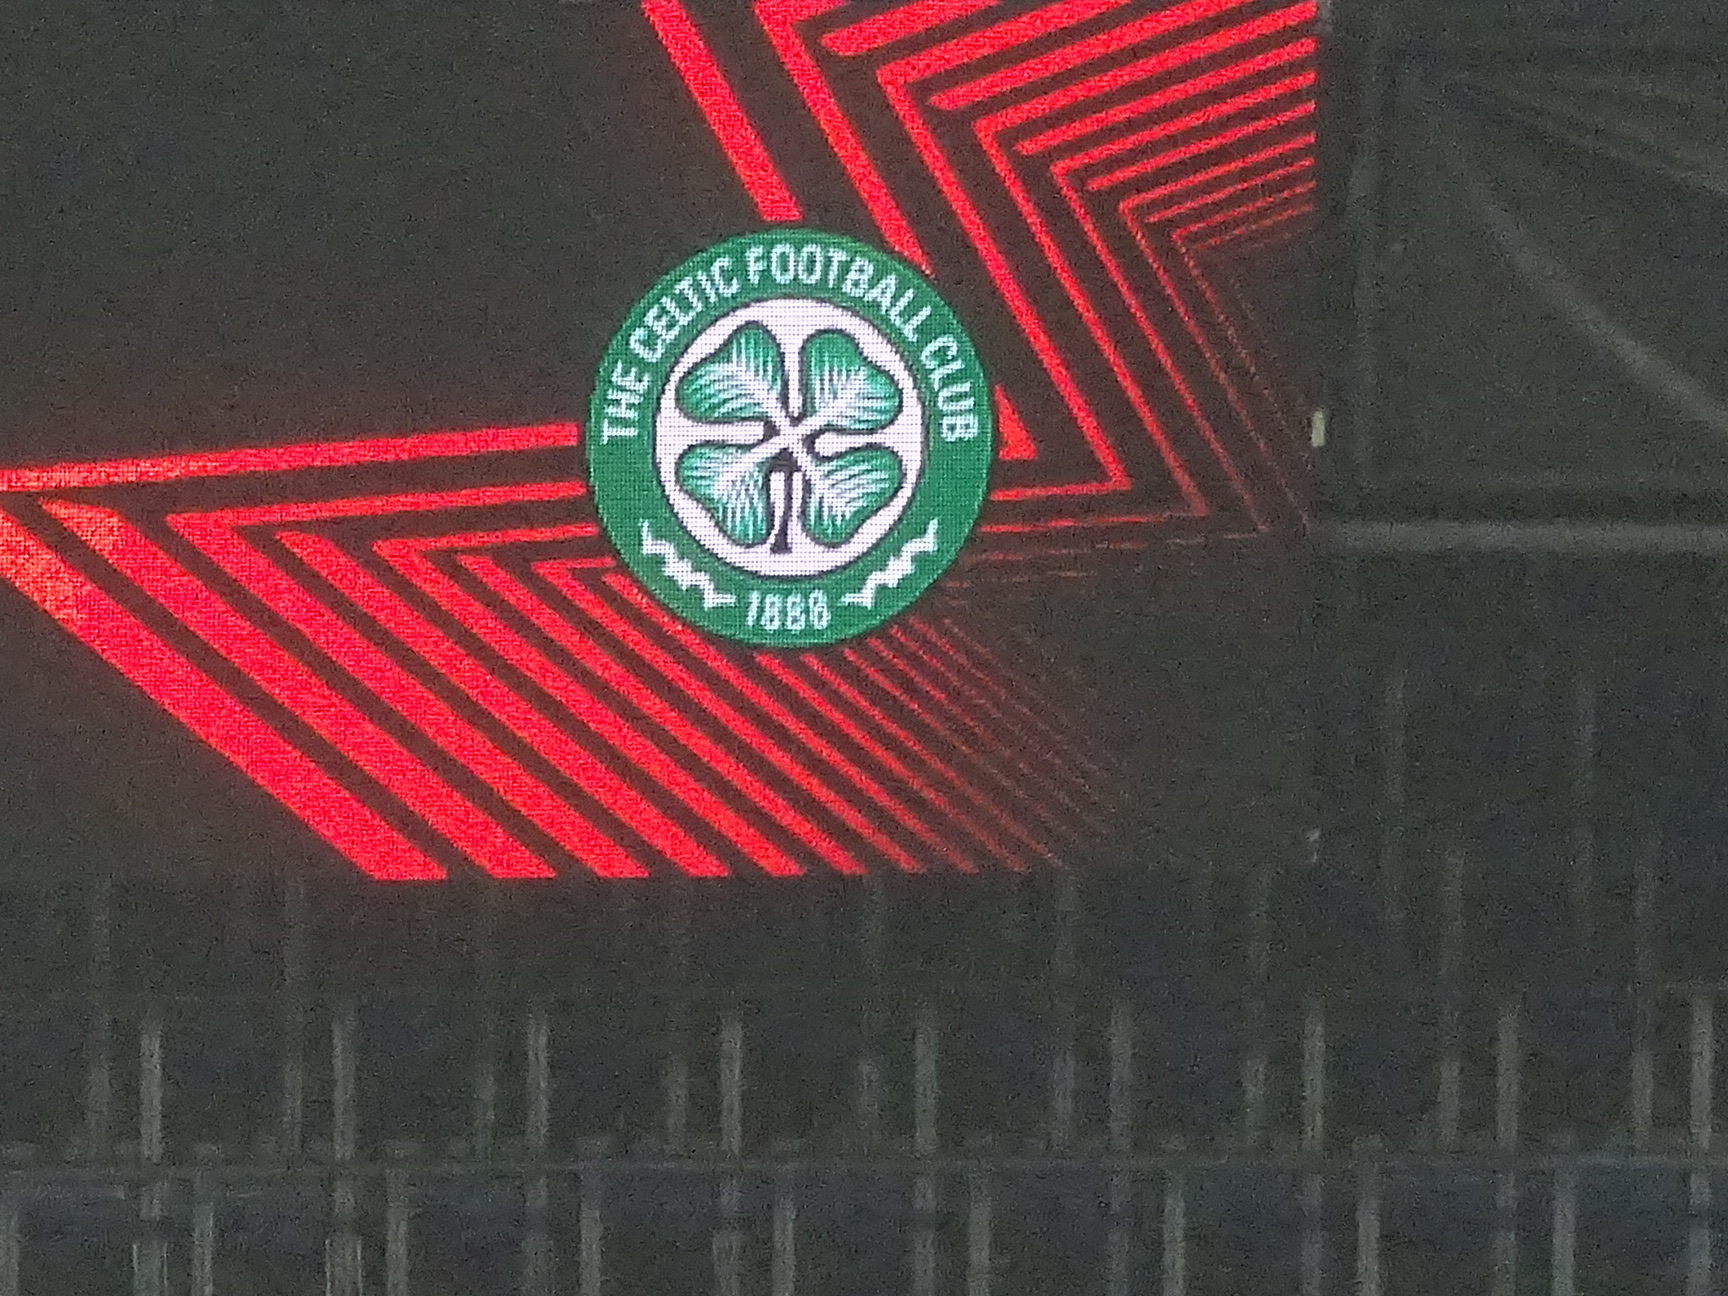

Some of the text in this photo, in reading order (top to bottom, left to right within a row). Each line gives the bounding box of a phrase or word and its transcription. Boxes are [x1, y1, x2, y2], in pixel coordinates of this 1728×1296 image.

[601, 242, 979, 445] THE CELTIC FOOTBALL CLUB
